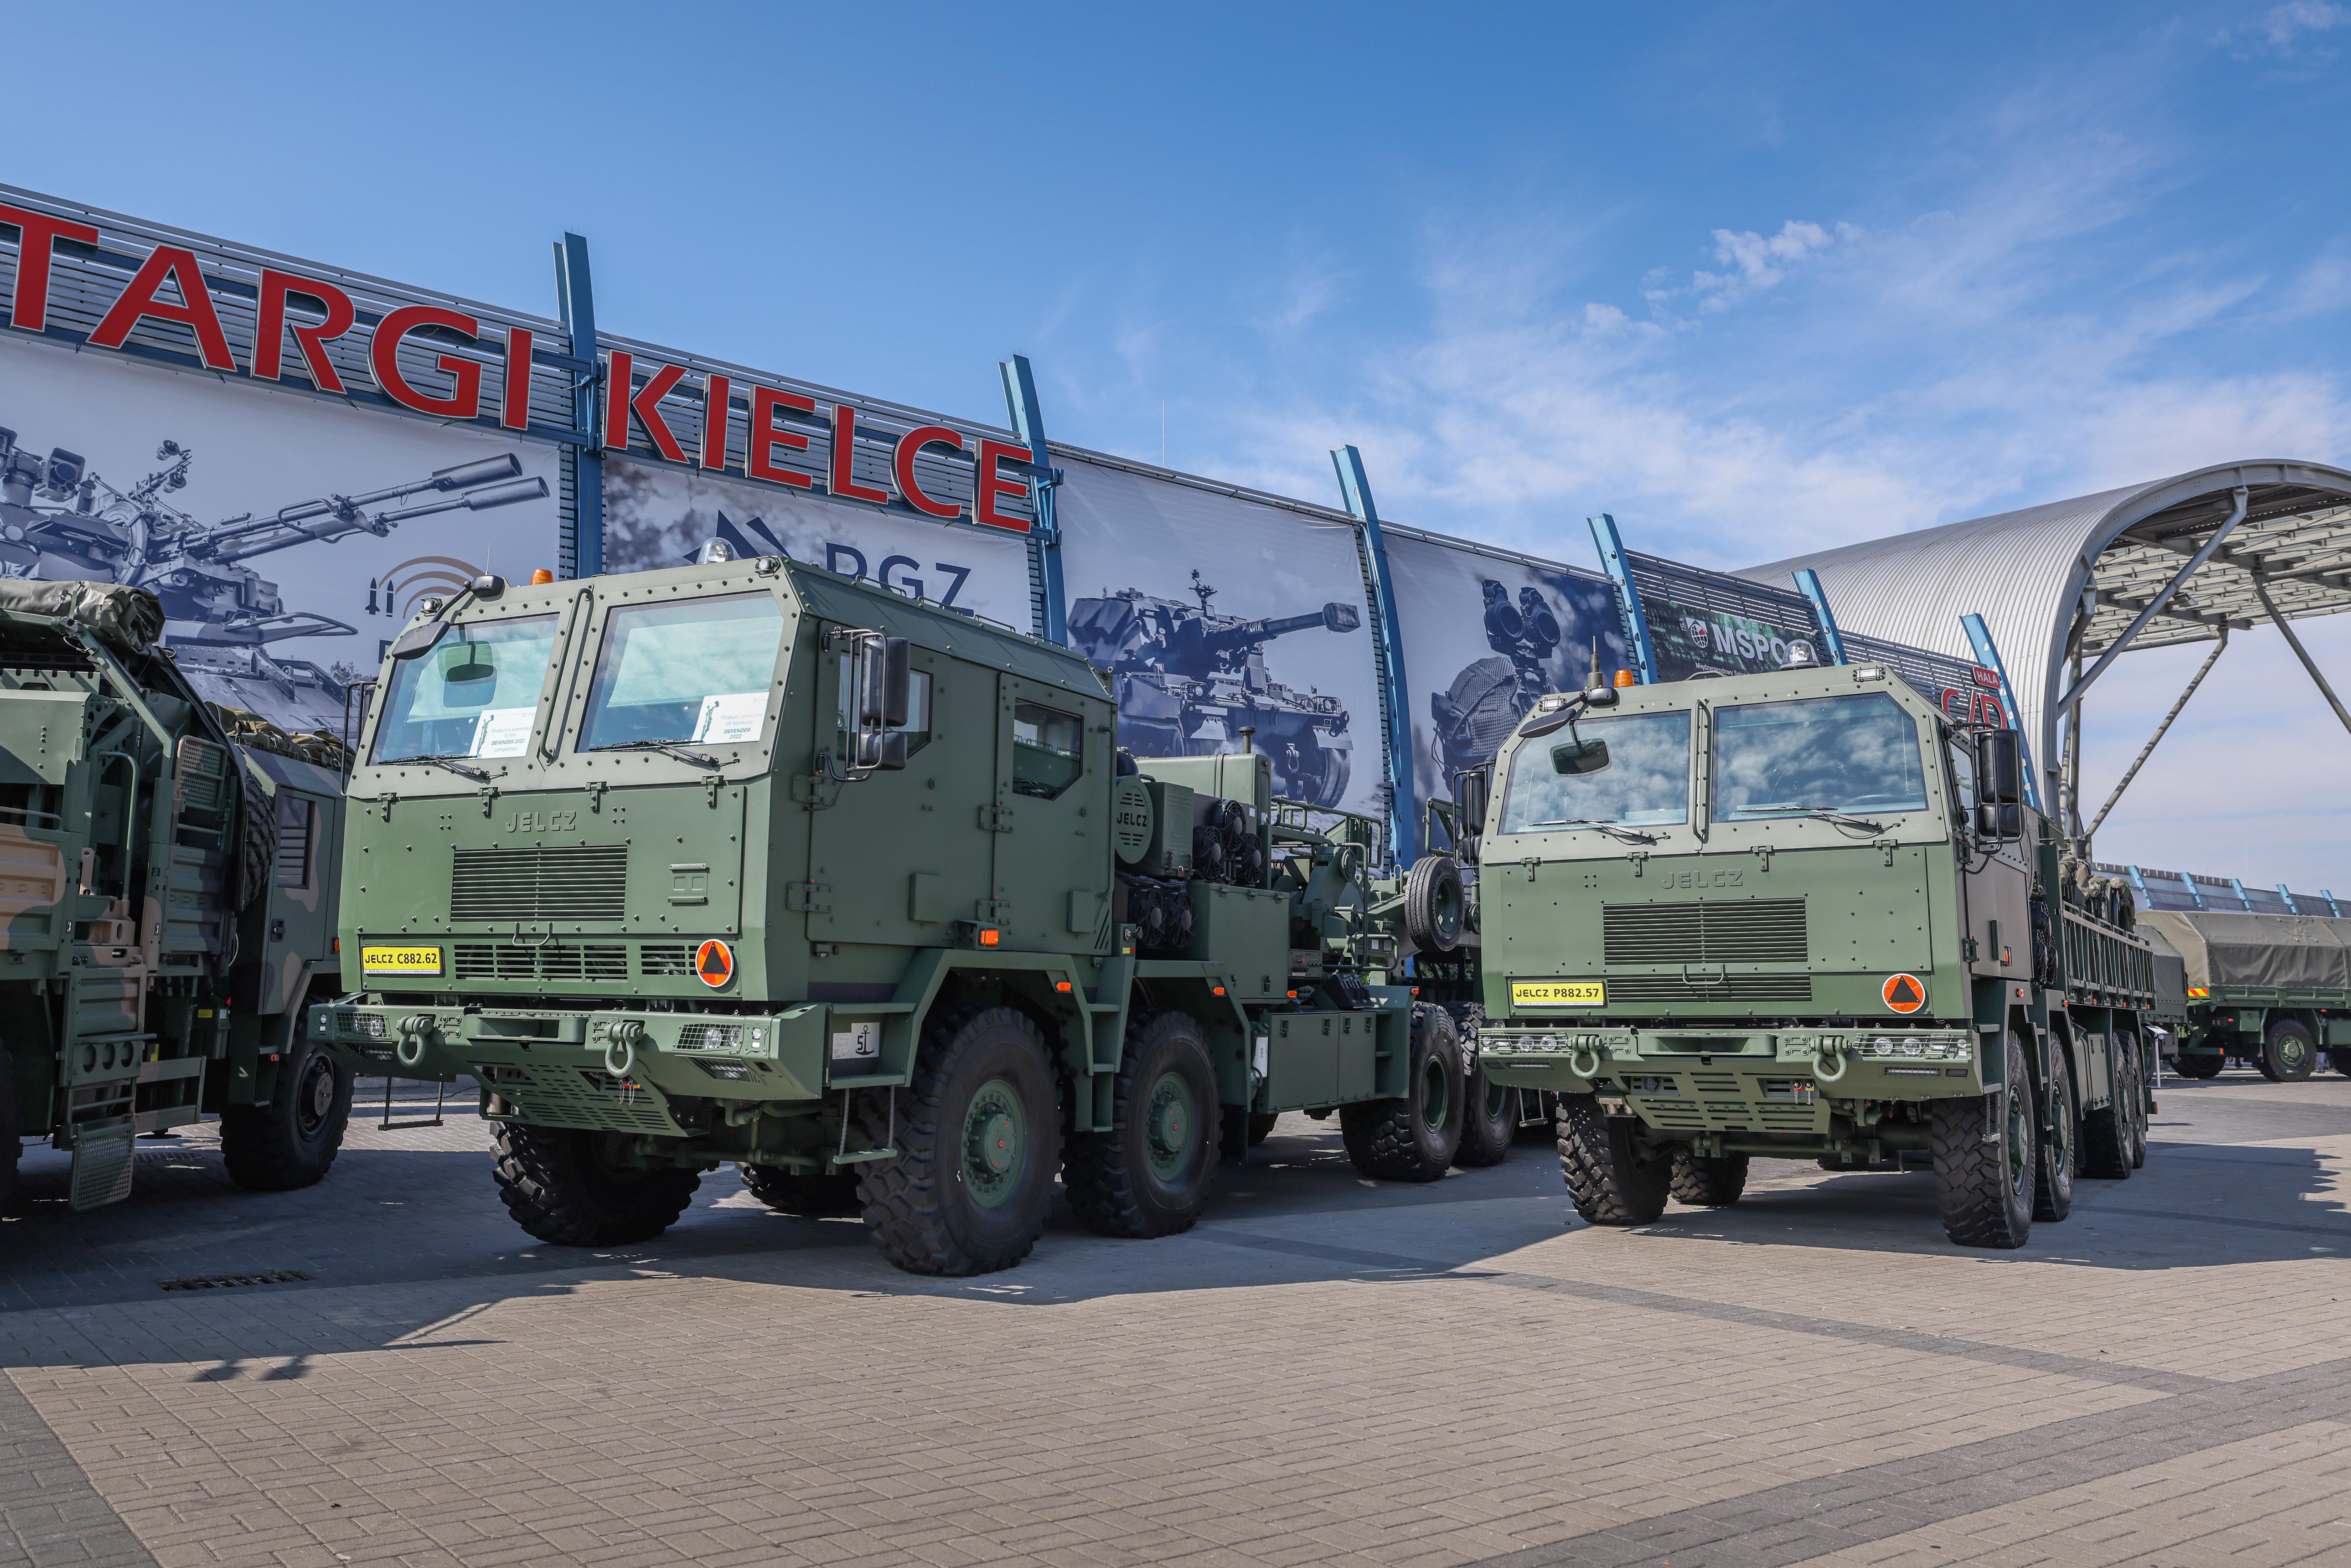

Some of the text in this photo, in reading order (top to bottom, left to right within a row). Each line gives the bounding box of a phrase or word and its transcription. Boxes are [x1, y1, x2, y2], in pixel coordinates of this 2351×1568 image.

[0, 202, 1033, 534] TARGI KIELCE
[1712, 624, 1788, 665] MSPO
[1976, 670, 1999, 686] HALA
[506, 810, 577, 833] JELCZ
[1116, 812, 1147, 827] JELCZ
[1660, 869, 1743, 889] JELCZ
[365, 953, 437, 964] JELCZ C882.62
[1516, 988, 1599, 998] JELCZ P882.57
[857, 1035, 863, 1051] 5
